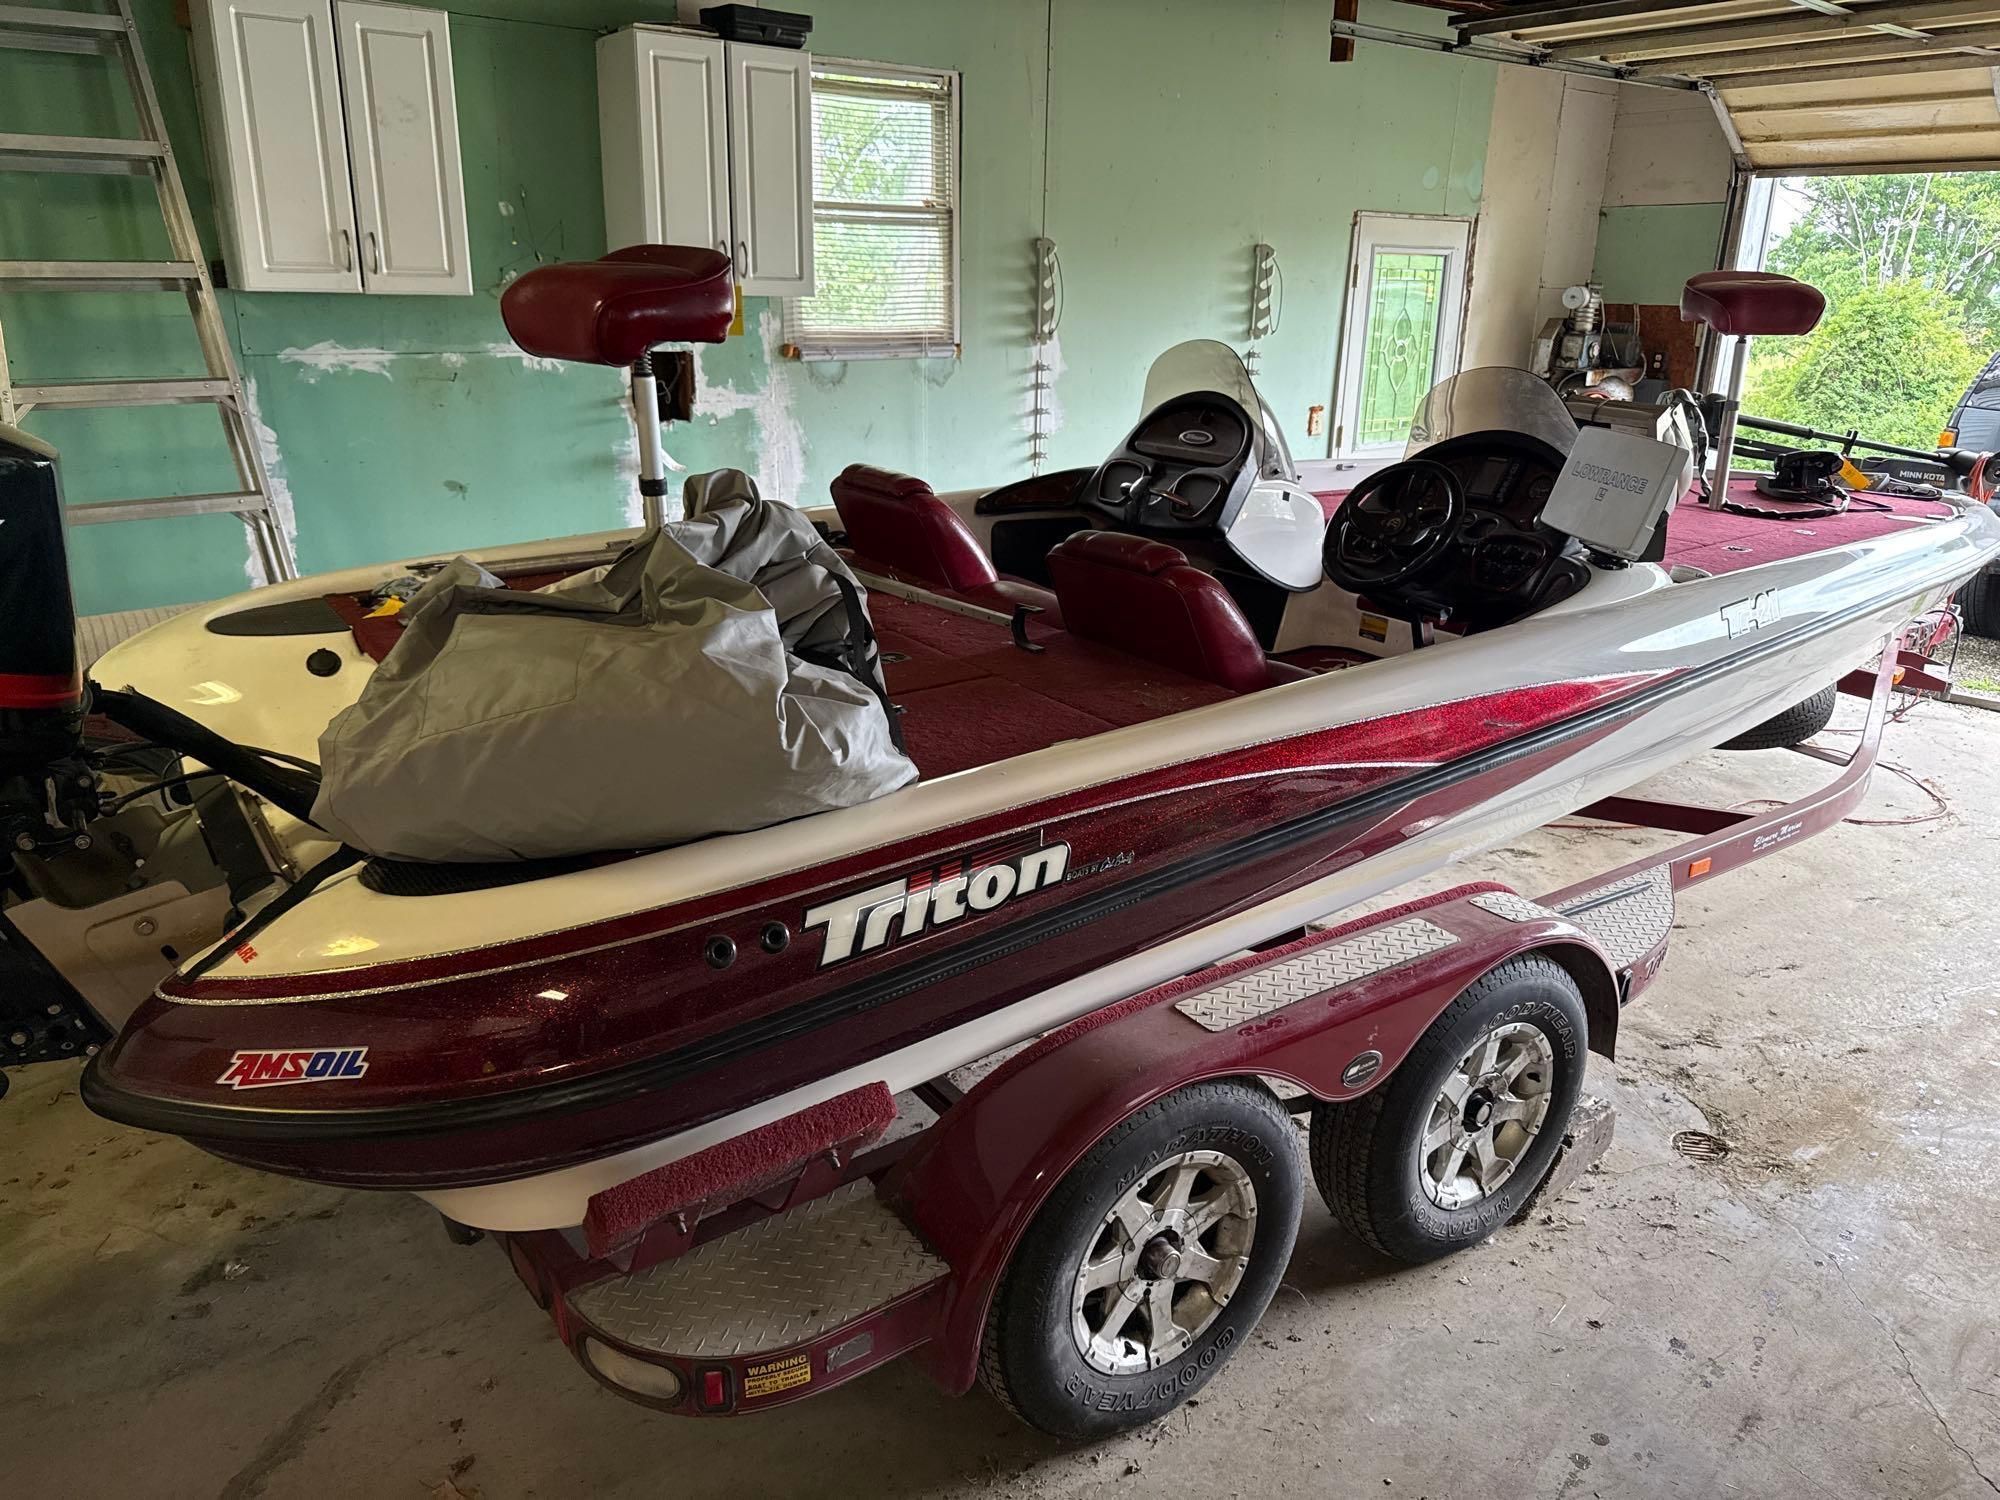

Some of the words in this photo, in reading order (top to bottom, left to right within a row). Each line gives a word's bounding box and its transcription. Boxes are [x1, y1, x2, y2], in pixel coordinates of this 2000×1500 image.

[1571, 461, 1648, 494] LOWRANCE
[1899, 470, 1922, 479] MINN
[1923, 472, 1946, 481] KOTA
[803, 842, 1070, 968] Triton
[224, 1050, 364, 1087] AMSOIL
[1116, 1126, 1274, 1195] MARATHON
[1409, 1192, 1511, 1238] MARATHON
[747, 1354, 807, 1377] WARNING
[747, 1373, 781, 1384] PROPERLY
[783, 1364, 809, 1376] SECURE
[1065, 1327, 1236, 1412] GOODYEAR
